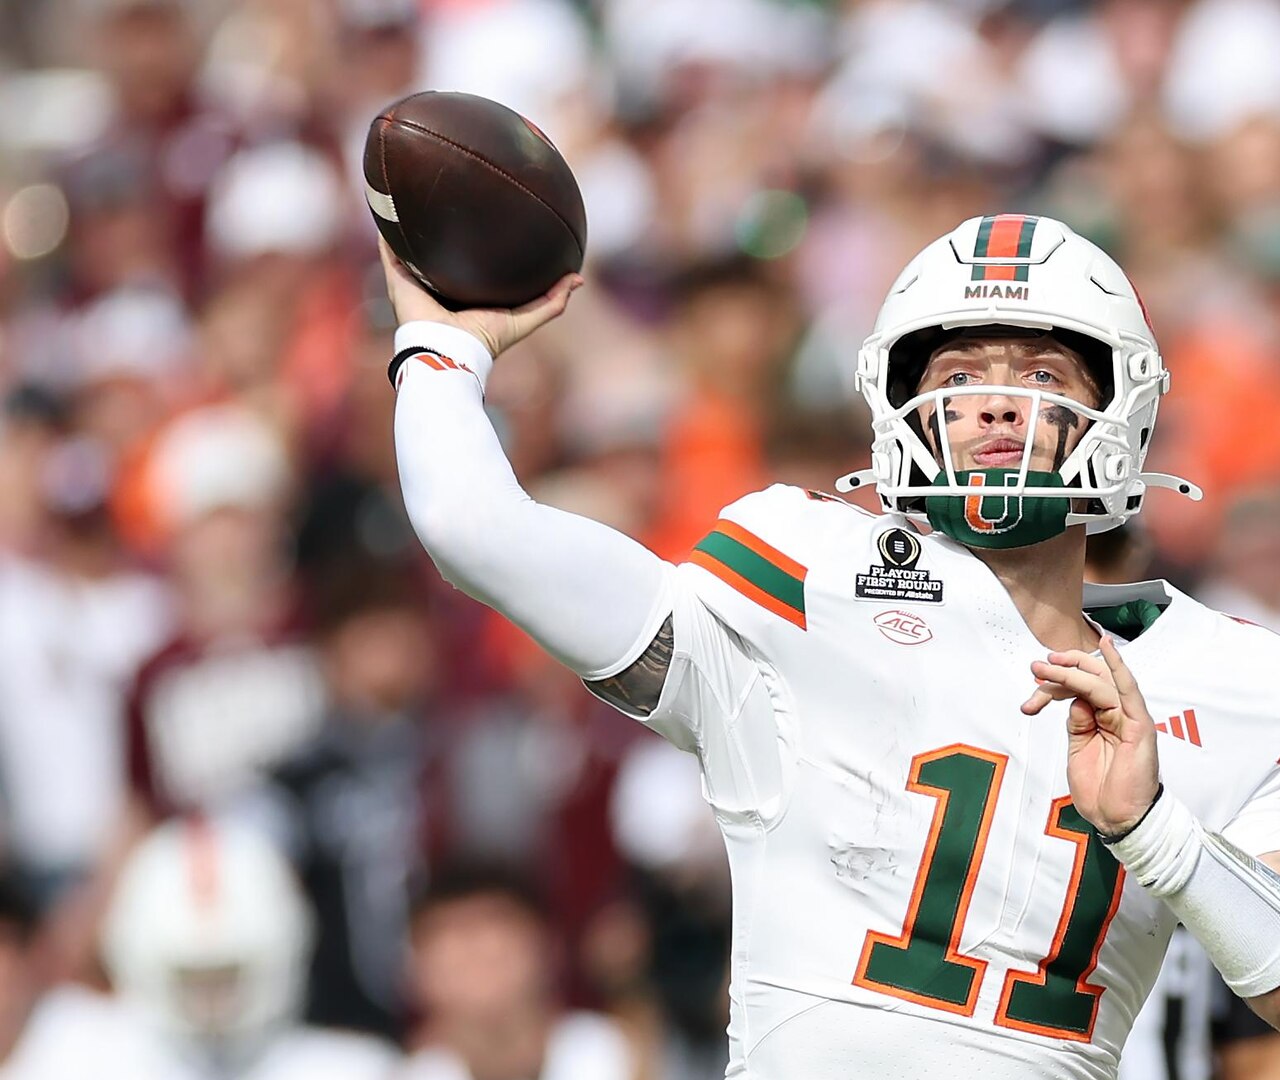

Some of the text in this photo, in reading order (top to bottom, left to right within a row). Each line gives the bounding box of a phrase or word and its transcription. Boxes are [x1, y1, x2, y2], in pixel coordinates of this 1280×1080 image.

[964, 285, 1029, 301] MIAMI
[872, 567, 927, 580] PLAYOFF
[858, 576, 941, 591] FIRST ROUND
[882, 618, 927, 636] ACC
[851, 742, 1127, 1044] 11
